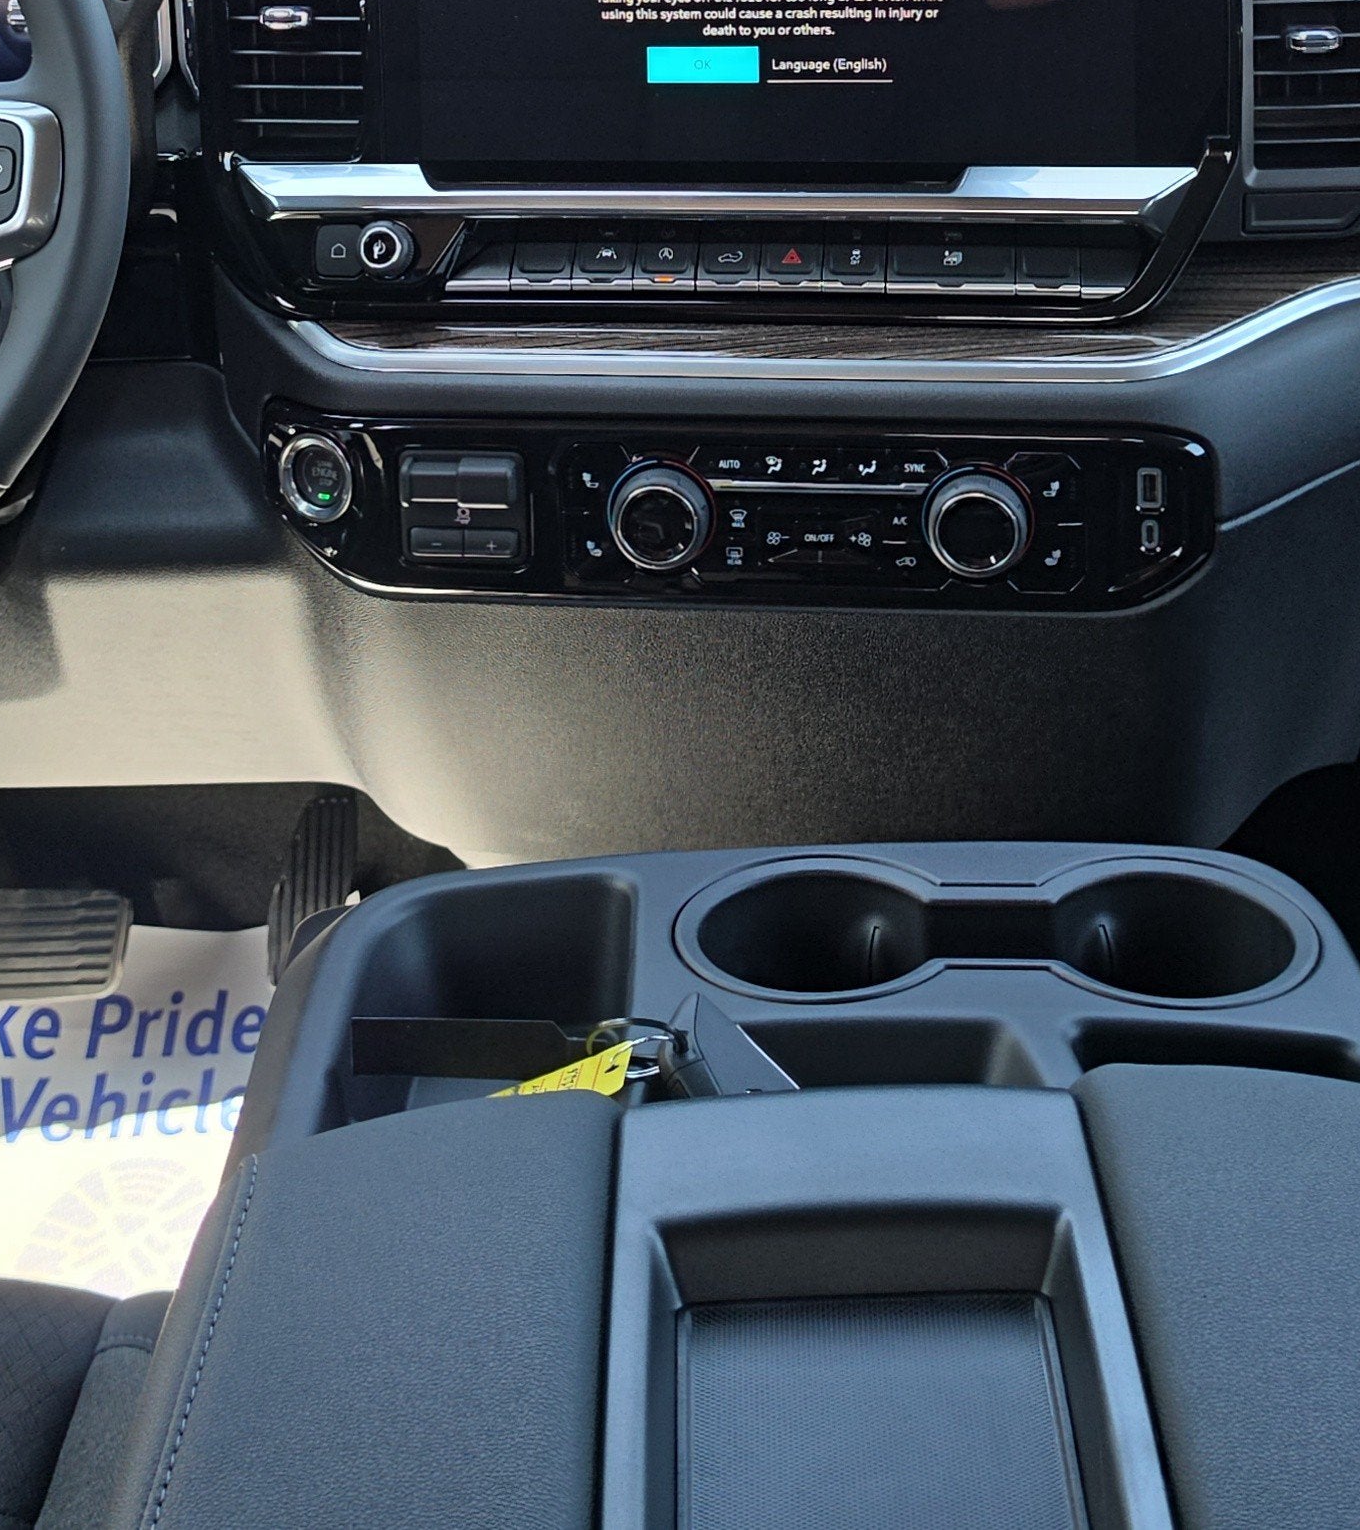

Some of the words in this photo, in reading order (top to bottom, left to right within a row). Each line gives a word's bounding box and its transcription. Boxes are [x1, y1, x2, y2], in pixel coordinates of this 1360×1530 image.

[601, 8, 634, 23] using
[636, 8, 658, 19] this
[659, 9, 702, 22] system
[704, 7, 736, 19] could
[738, 9, 773, 19] cause
[775, 10, 783, 19] a
[785, 7, 817, 19] crash
[819, 6, 872, 21] resulting
[874, 7, 886, 18] in
[889, 7, 923, 21] injury
[925, 9, 939, 18] or
[702, 24, 736, 36] death
[739, 25, 751, 36] to
[753, 27, 775, 39] you
[777, 27, 791, 35] or
[793, 24, 835, 36] others.
[694, 59, 711, 70] OK
[771, 58, 831, 73] Language
[833, 58, 887, 73] (English)
[718, 459, 740, 469] AUTO
[904, 463, 926, 473] SYNC
[892, 516, 908, 526] A/C
[804, 533, 835, 543] ON/OFF
[84, 988, 266, 1059] Pride
